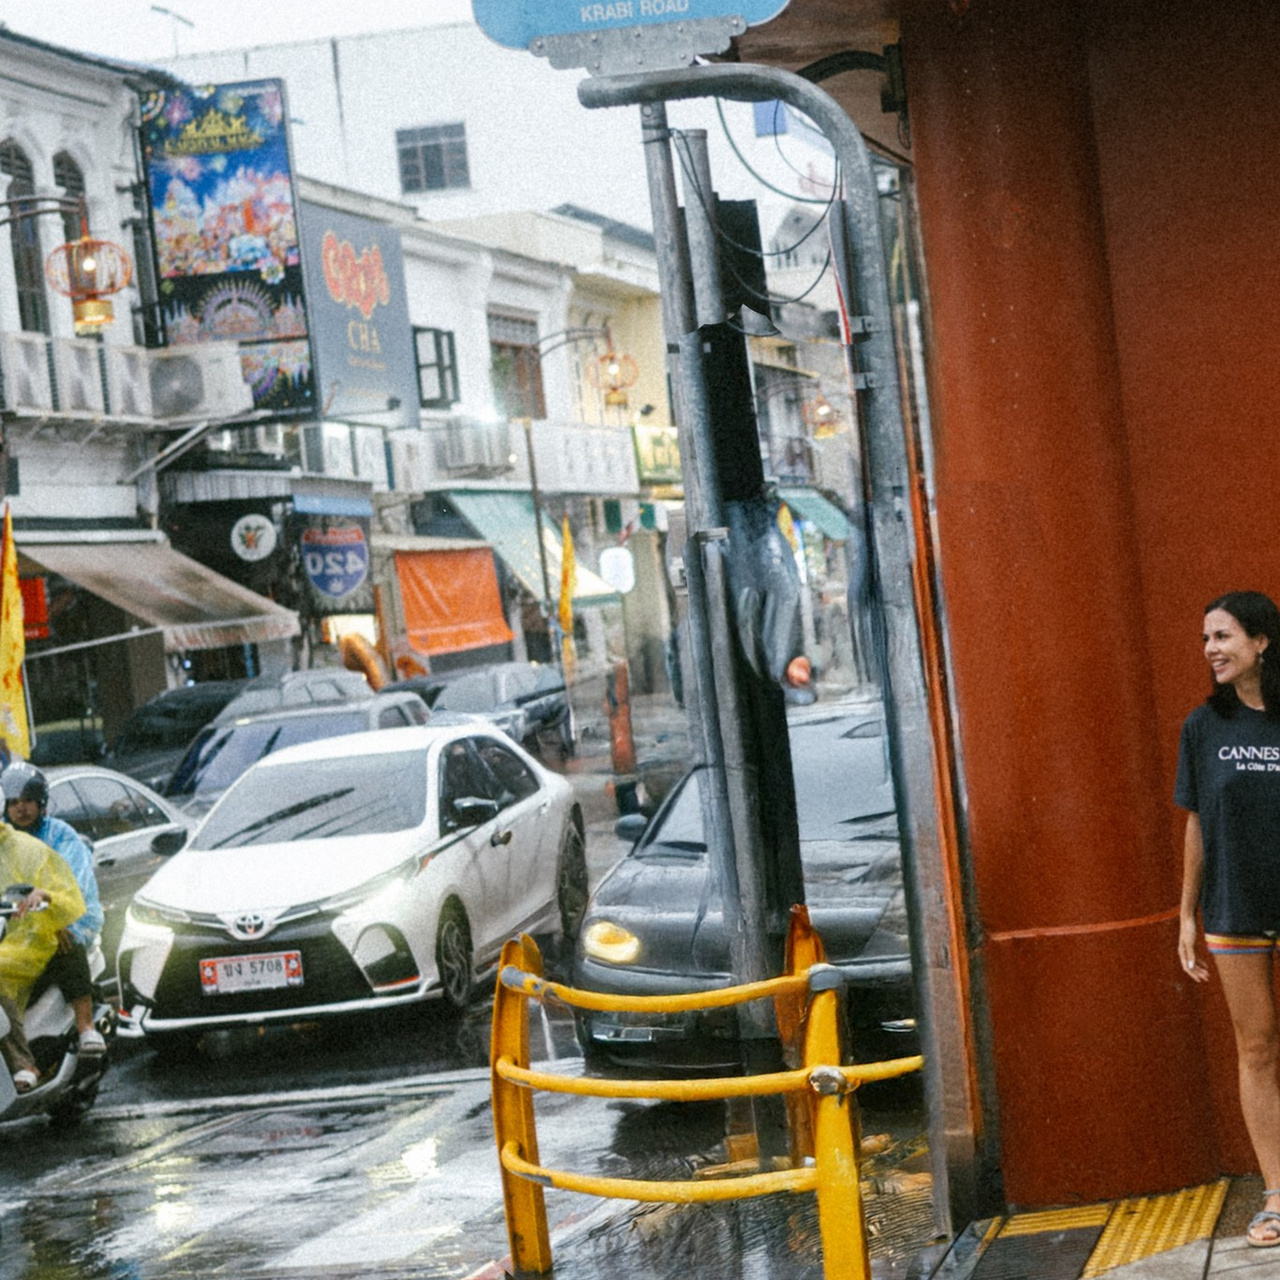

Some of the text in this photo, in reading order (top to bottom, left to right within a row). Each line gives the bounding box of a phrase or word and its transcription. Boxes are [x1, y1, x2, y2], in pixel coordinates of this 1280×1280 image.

[580, 0, 633, 23] KRABI
[348, 320, 382, 354] CHA
[1218, 746, 1280, 760] CANNES
[1236, 762, 1245, 770] La
[1247, 762, 1265, 771] Côte
